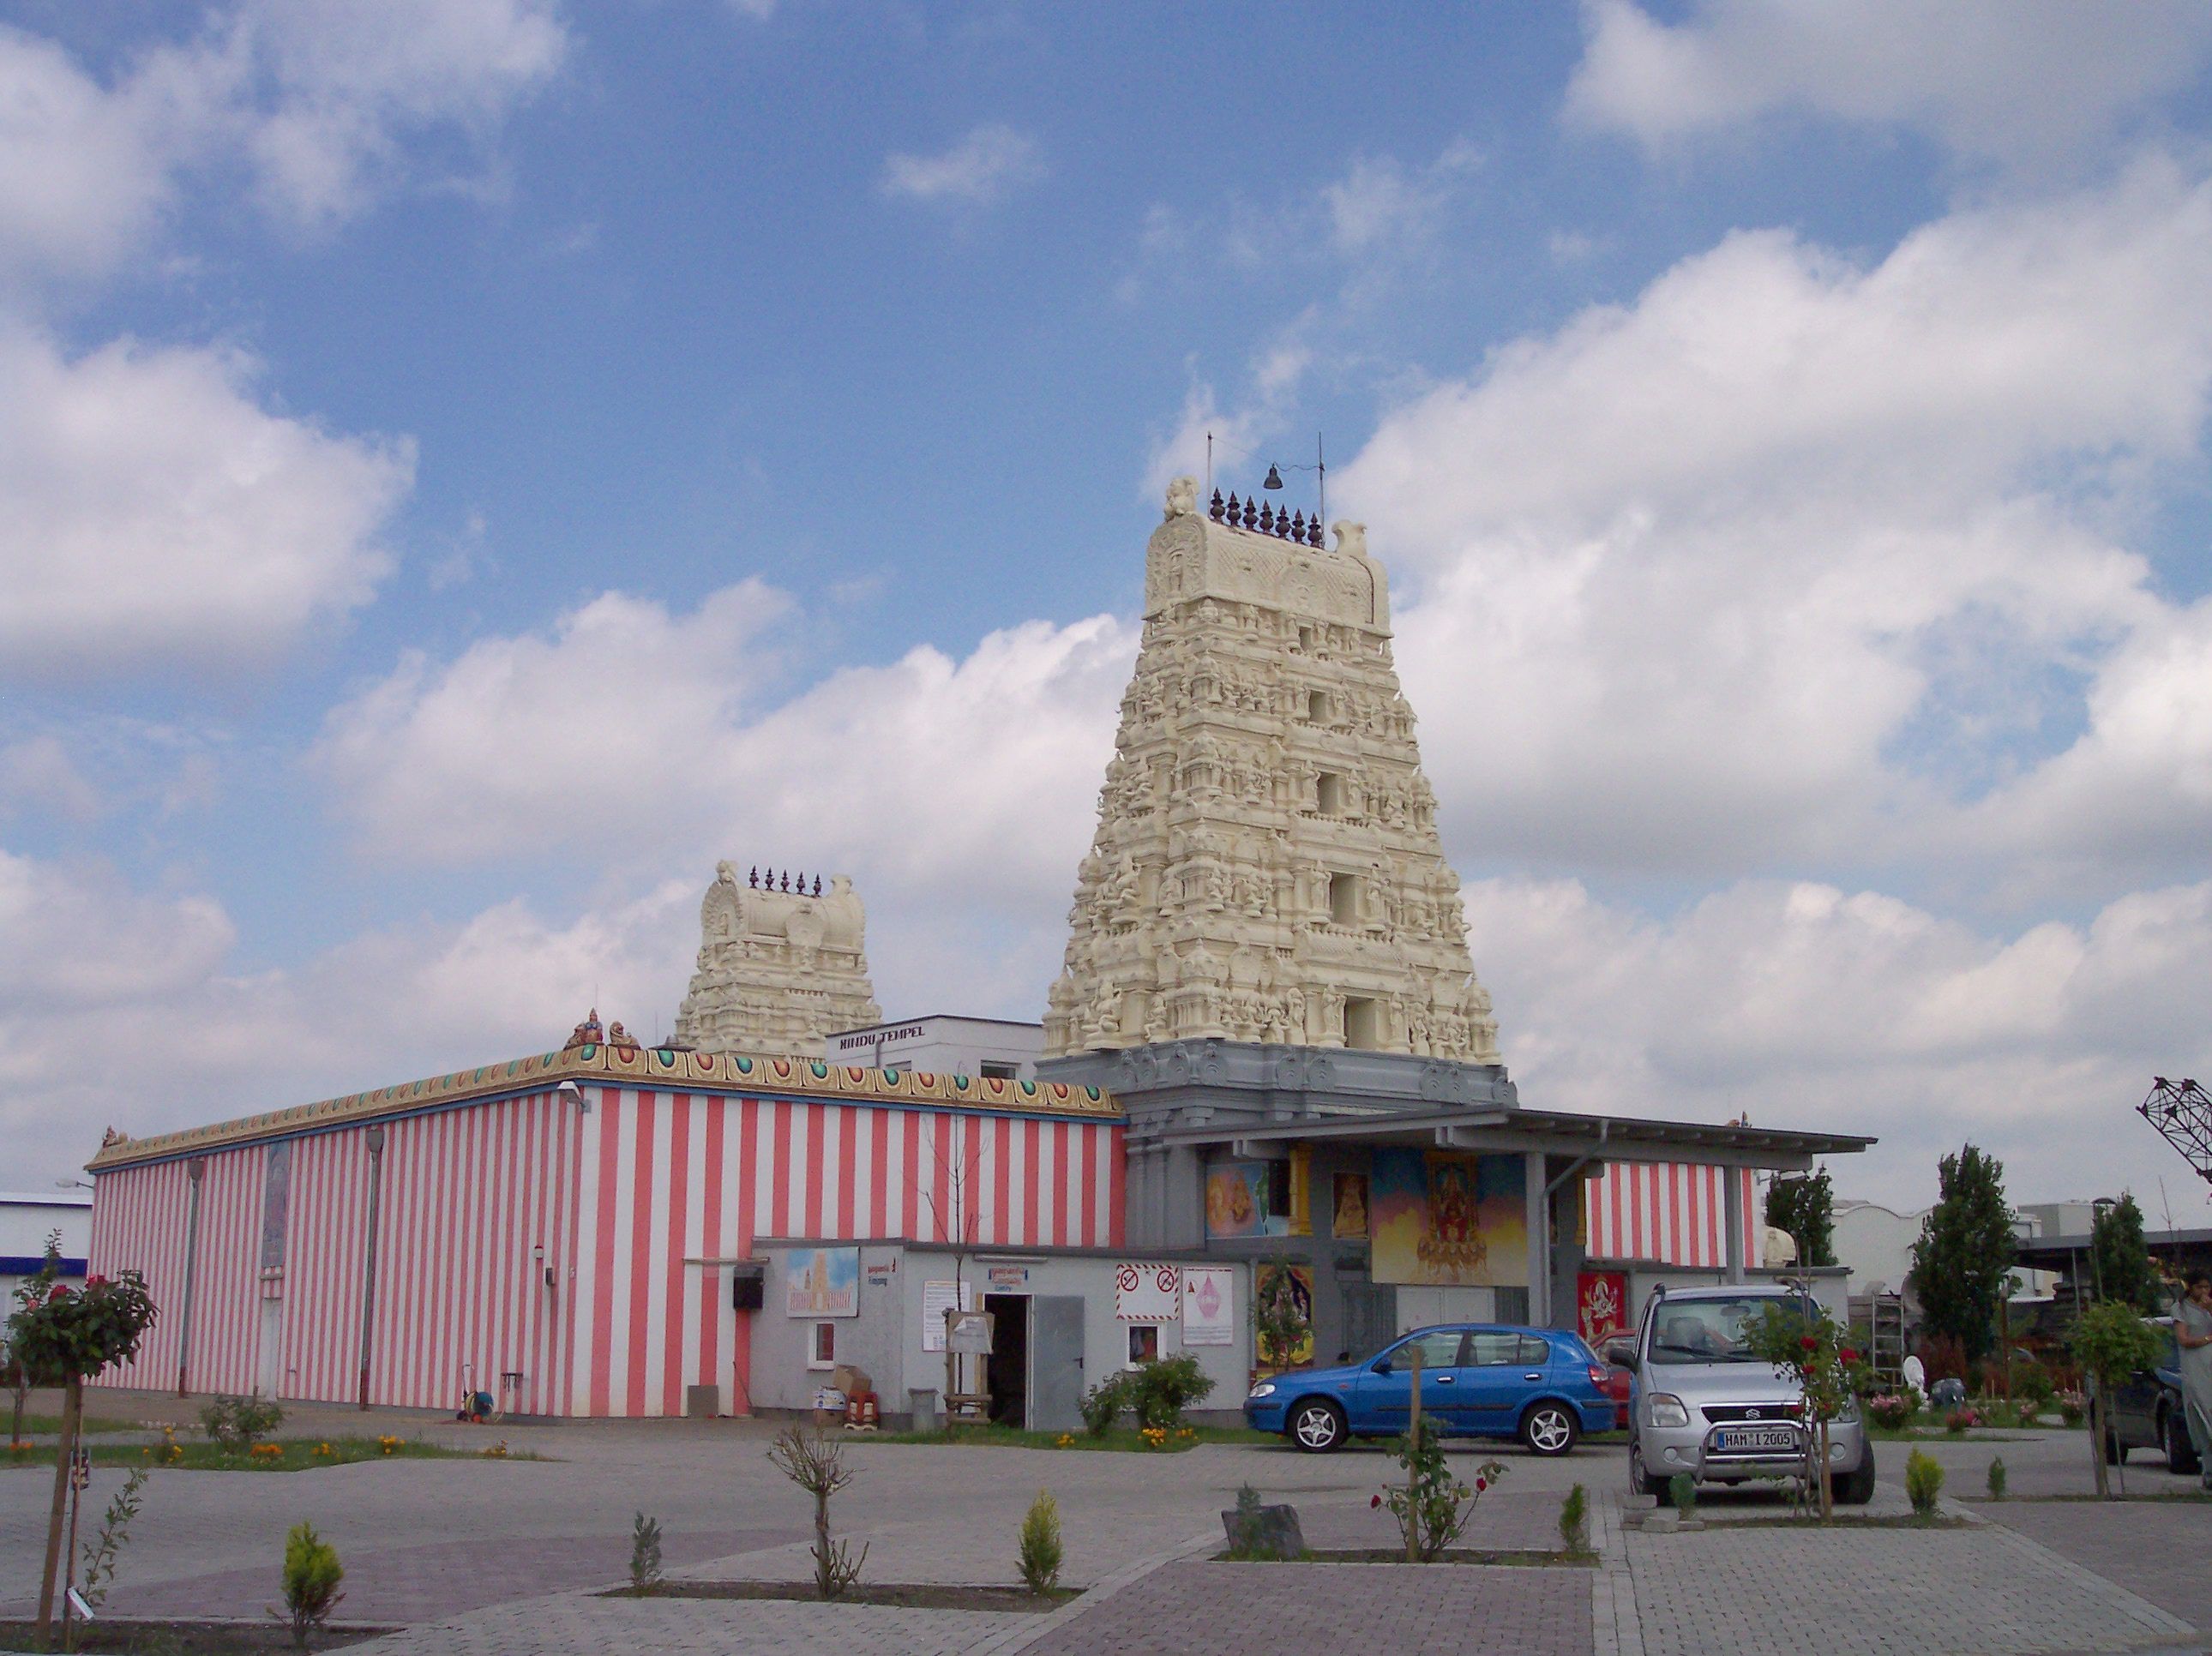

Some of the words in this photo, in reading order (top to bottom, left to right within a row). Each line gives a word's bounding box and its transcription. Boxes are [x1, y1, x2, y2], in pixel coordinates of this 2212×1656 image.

[840, 1034, 875, 1050] HINDU
[880, 1026, 925, 1043] TEMPEL
[1725, 1434, 1747, 1446] HAM
[1763, 1432, 1790, 1445] 2005
